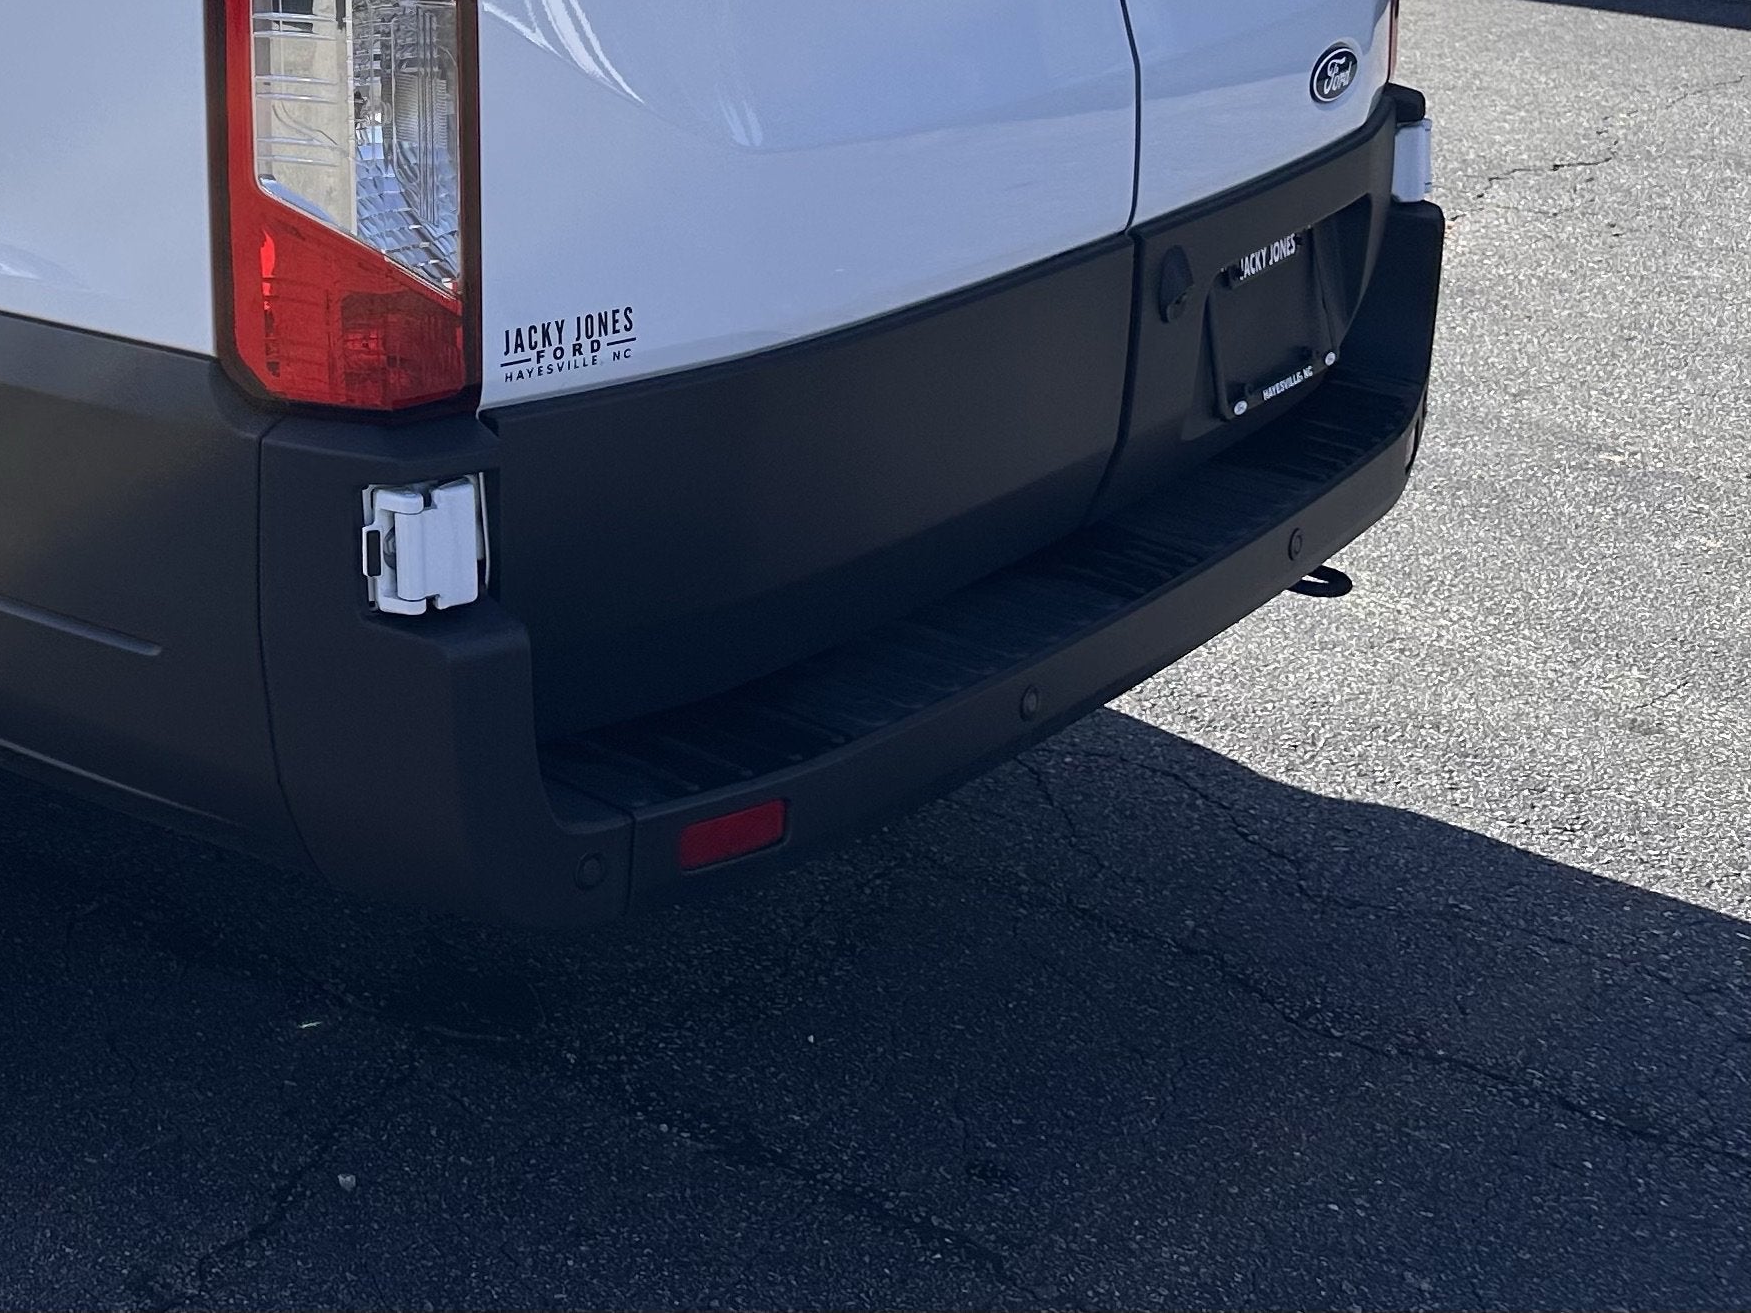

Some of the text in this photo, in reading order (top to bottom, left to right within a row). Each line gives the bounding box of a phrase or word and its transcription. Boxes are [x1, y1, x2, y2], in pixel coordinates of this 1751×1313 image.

[1323, 56, 1353, 95] Ford
[1239, 232, 1296, 281] JACKY JONES
[503, 306, 634, 357] JACKY JONES
[536, 338, 601, 365] FORD
[612, 347, 633, 362] NC
